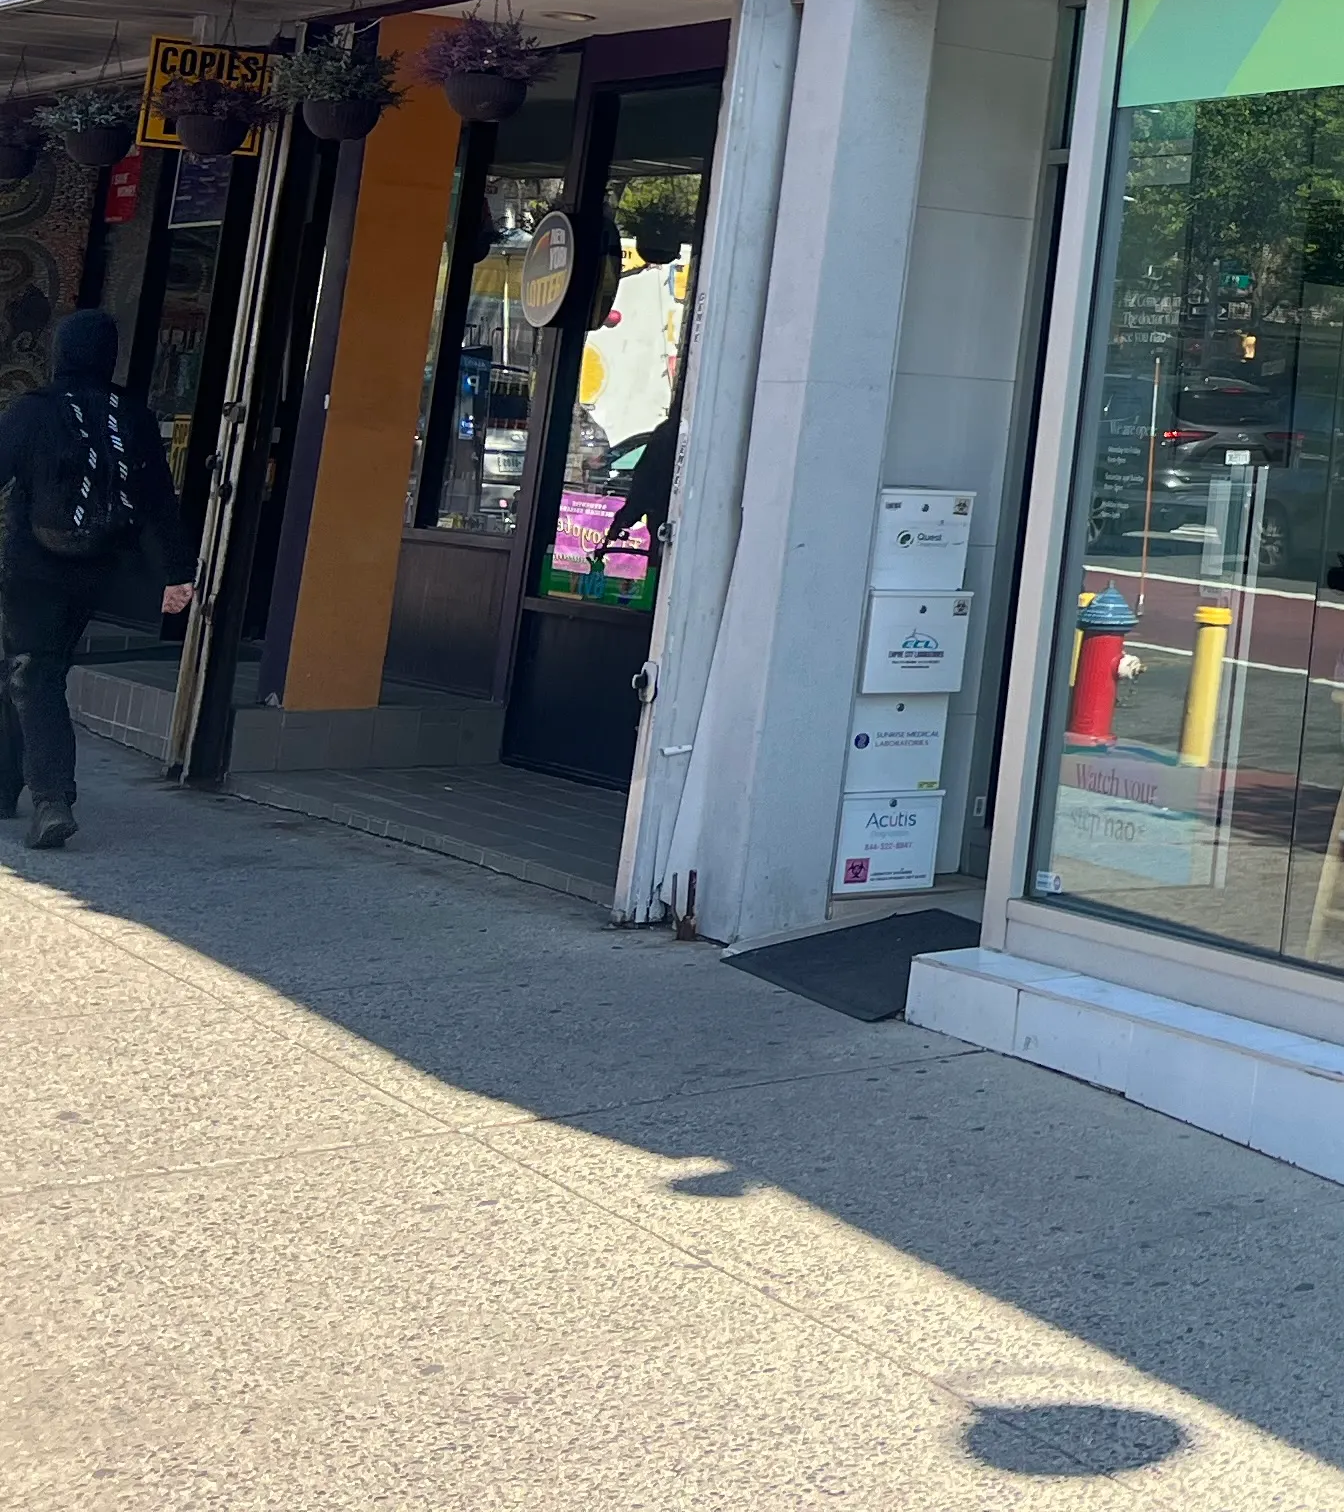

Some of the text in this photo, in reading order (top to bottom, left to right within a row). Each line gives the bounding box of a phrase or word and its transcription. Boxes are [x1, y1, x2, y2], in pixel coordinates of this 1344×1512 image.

[160, 46, 260, 84] COPIES
[917, 532, 942, 542] Quest
[1076, 763, 1158, 805] Watch your
[865, 811, 917, 830] Acutis
